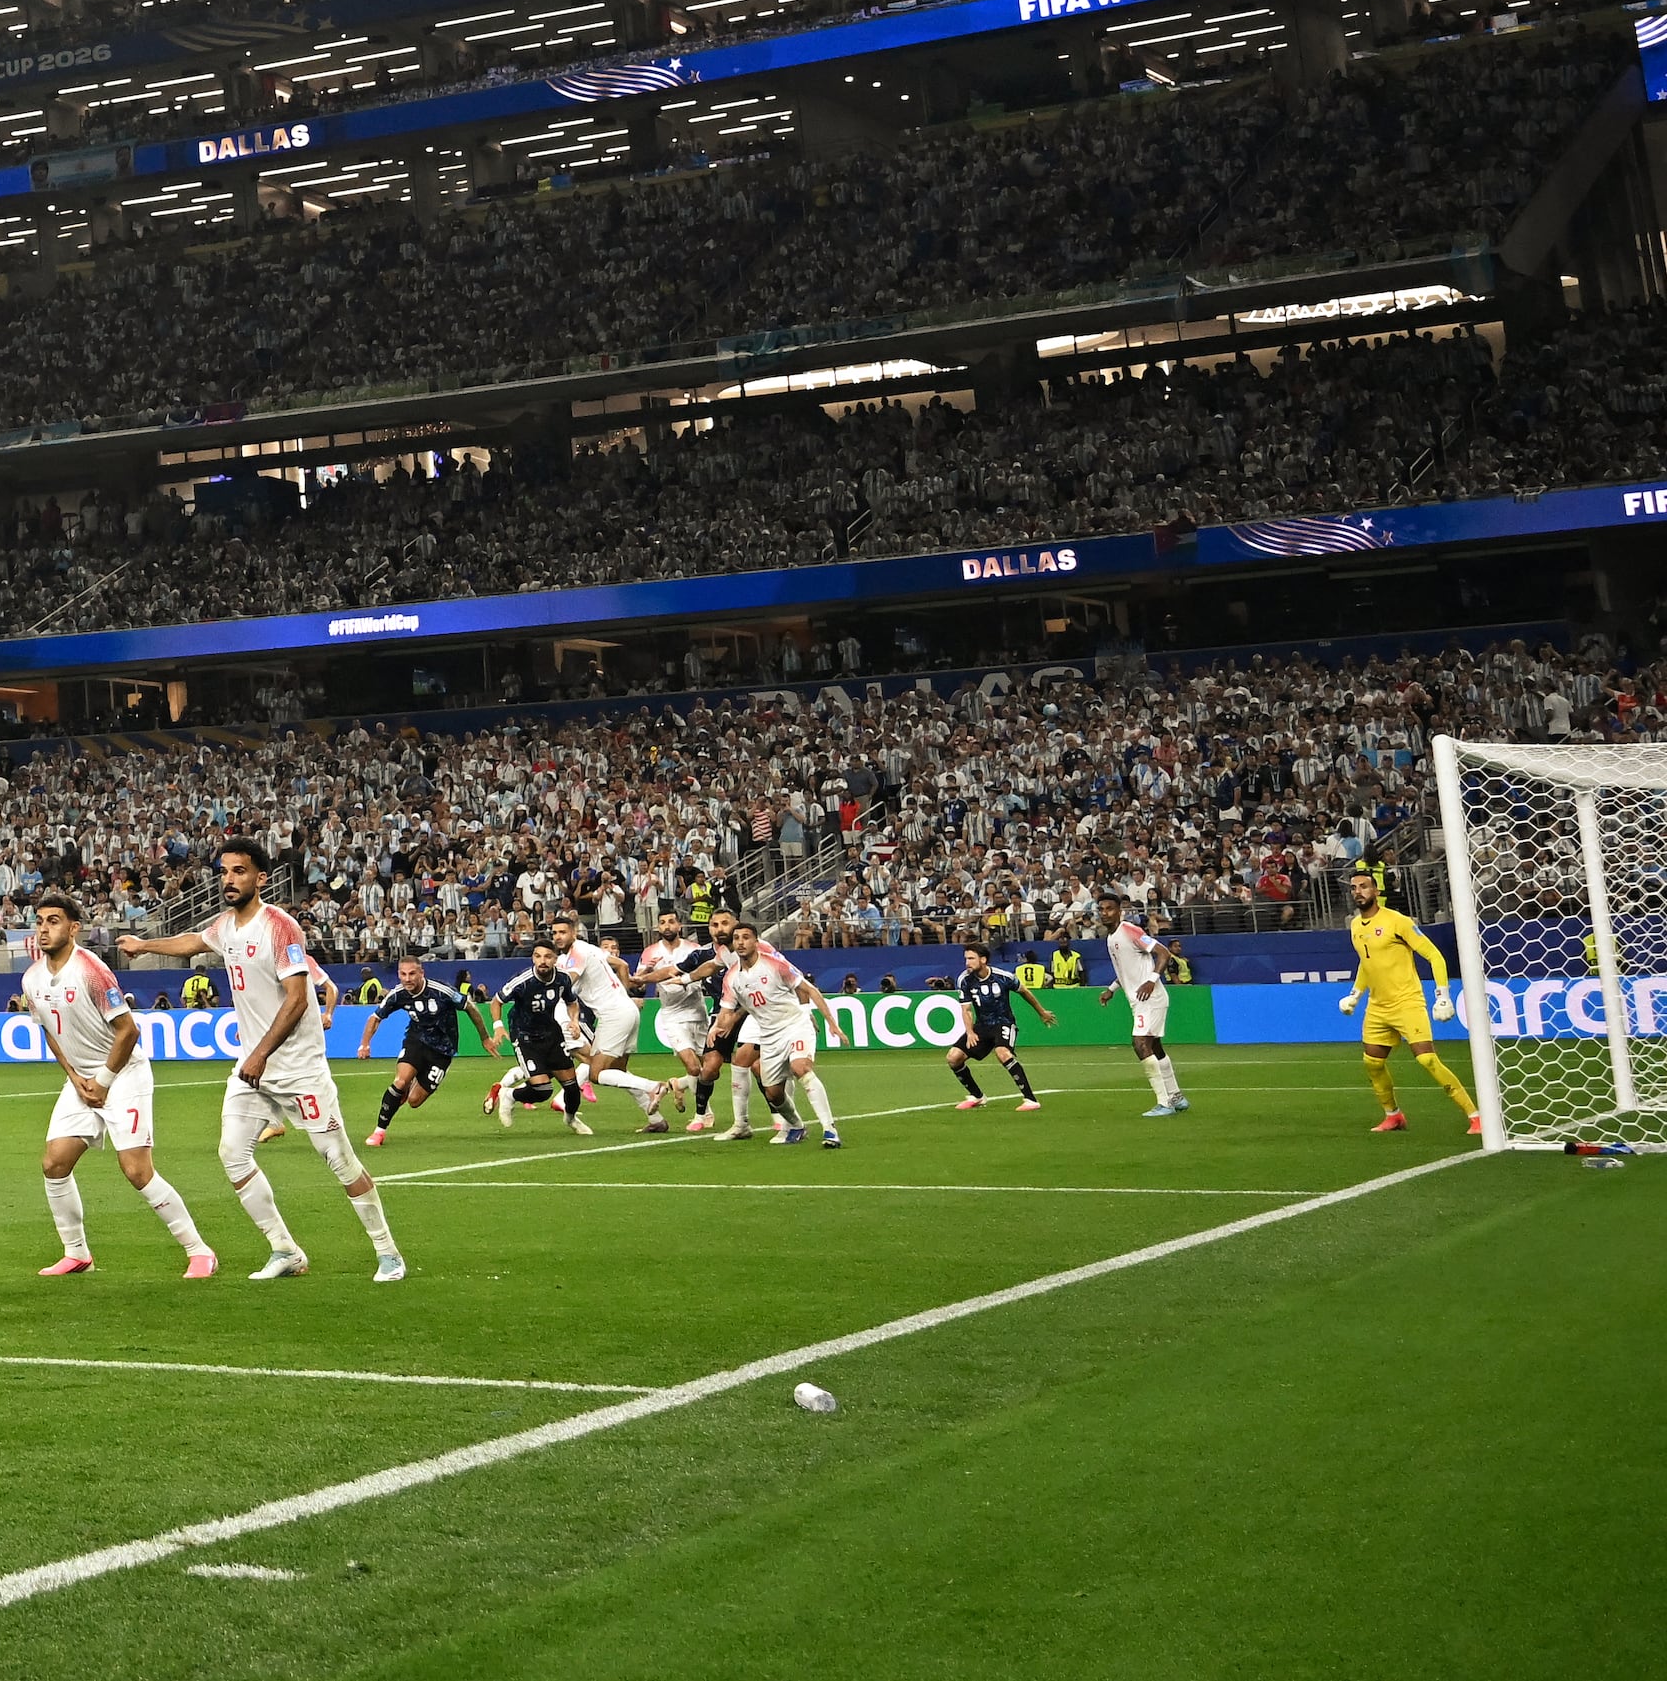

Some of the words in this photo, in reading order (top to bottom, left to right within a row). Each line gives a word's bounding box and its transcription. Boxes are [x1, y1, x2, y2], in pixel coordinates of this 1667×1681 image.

[37, 43, 112, 73] 2026
[198, 124, 310, 164] DALLAS
[962, 548, 1077, 583] DALLAS
[328, 613, 419, 637] #FIFAWorldCup
[1364, 944, 1370, 959] 1
[229, 965, 245, 992] 13
[531, 999, 546, 1012] 21
[748, 991, 766, 1008] 20
[51, 1009, 62, 1035] 7
[1138, 1015, 1145, 1029] 3
[790, 1039, 804, 1053] 20
[427, 1065, 444, 1084] 20
[295, 1094, 321, 1121] 13
[127, 1108, 139, 1134] 7
